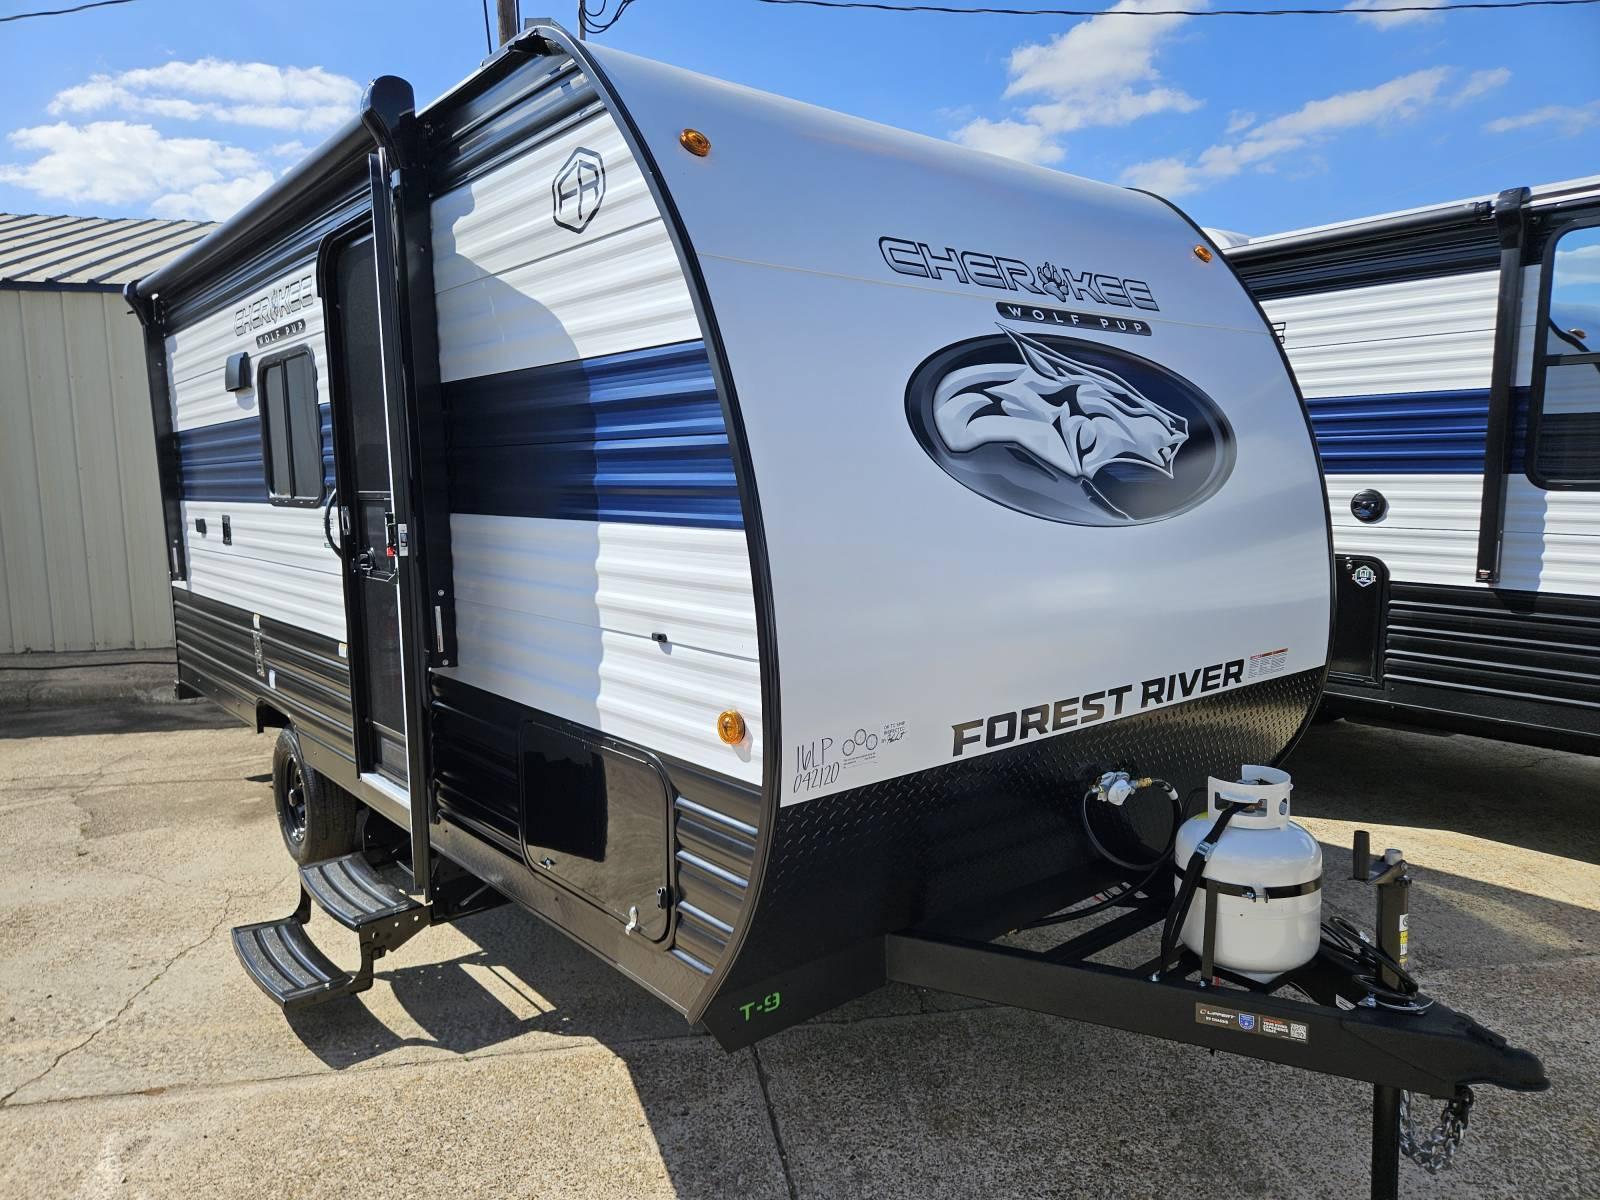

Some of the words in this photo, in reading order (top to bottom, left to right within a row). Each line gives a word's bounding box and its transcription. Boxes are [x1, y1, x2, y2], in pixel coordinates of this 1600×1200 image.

[257, 330, 280, 345] WOLF
[285, 321, 304, 336] PUP
[1007, 305, 1081, 325] WOLF
[1099, 318, 1143, 333] PUP
[951, 684, 1133, 757] FOREST
[1140, 658, 1245, 709] RIVER
[793, 761, 840, 794] 042120
[739, 991, 781, 1022] T-9
